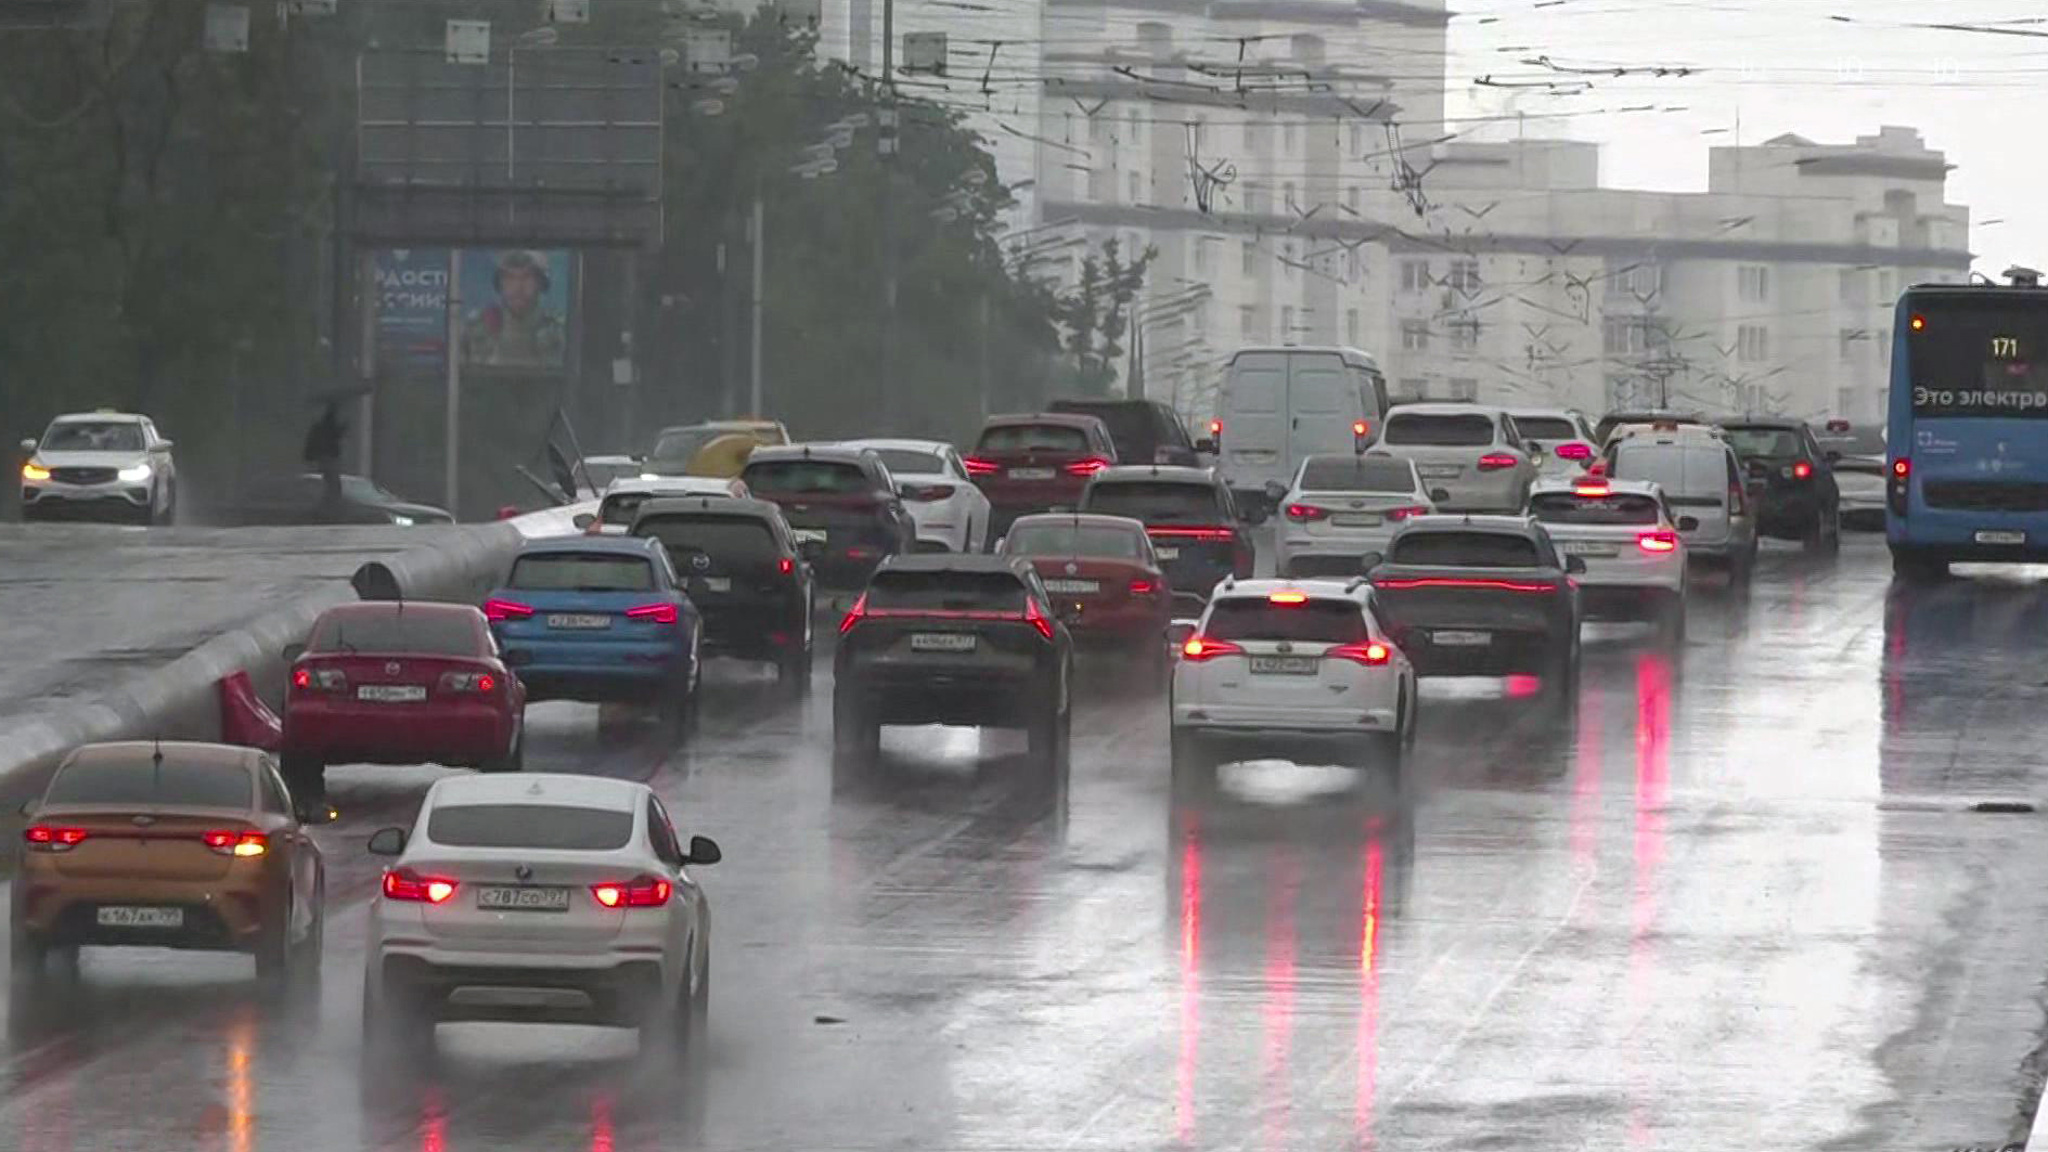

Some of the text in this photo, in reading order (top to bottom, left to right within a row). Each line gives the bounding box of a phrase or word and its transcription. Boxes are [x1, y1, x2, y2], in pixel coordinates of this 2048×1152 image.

[1992, 338, 2017, 356] 171
[1914, 386, 2047, 410] Это электро
